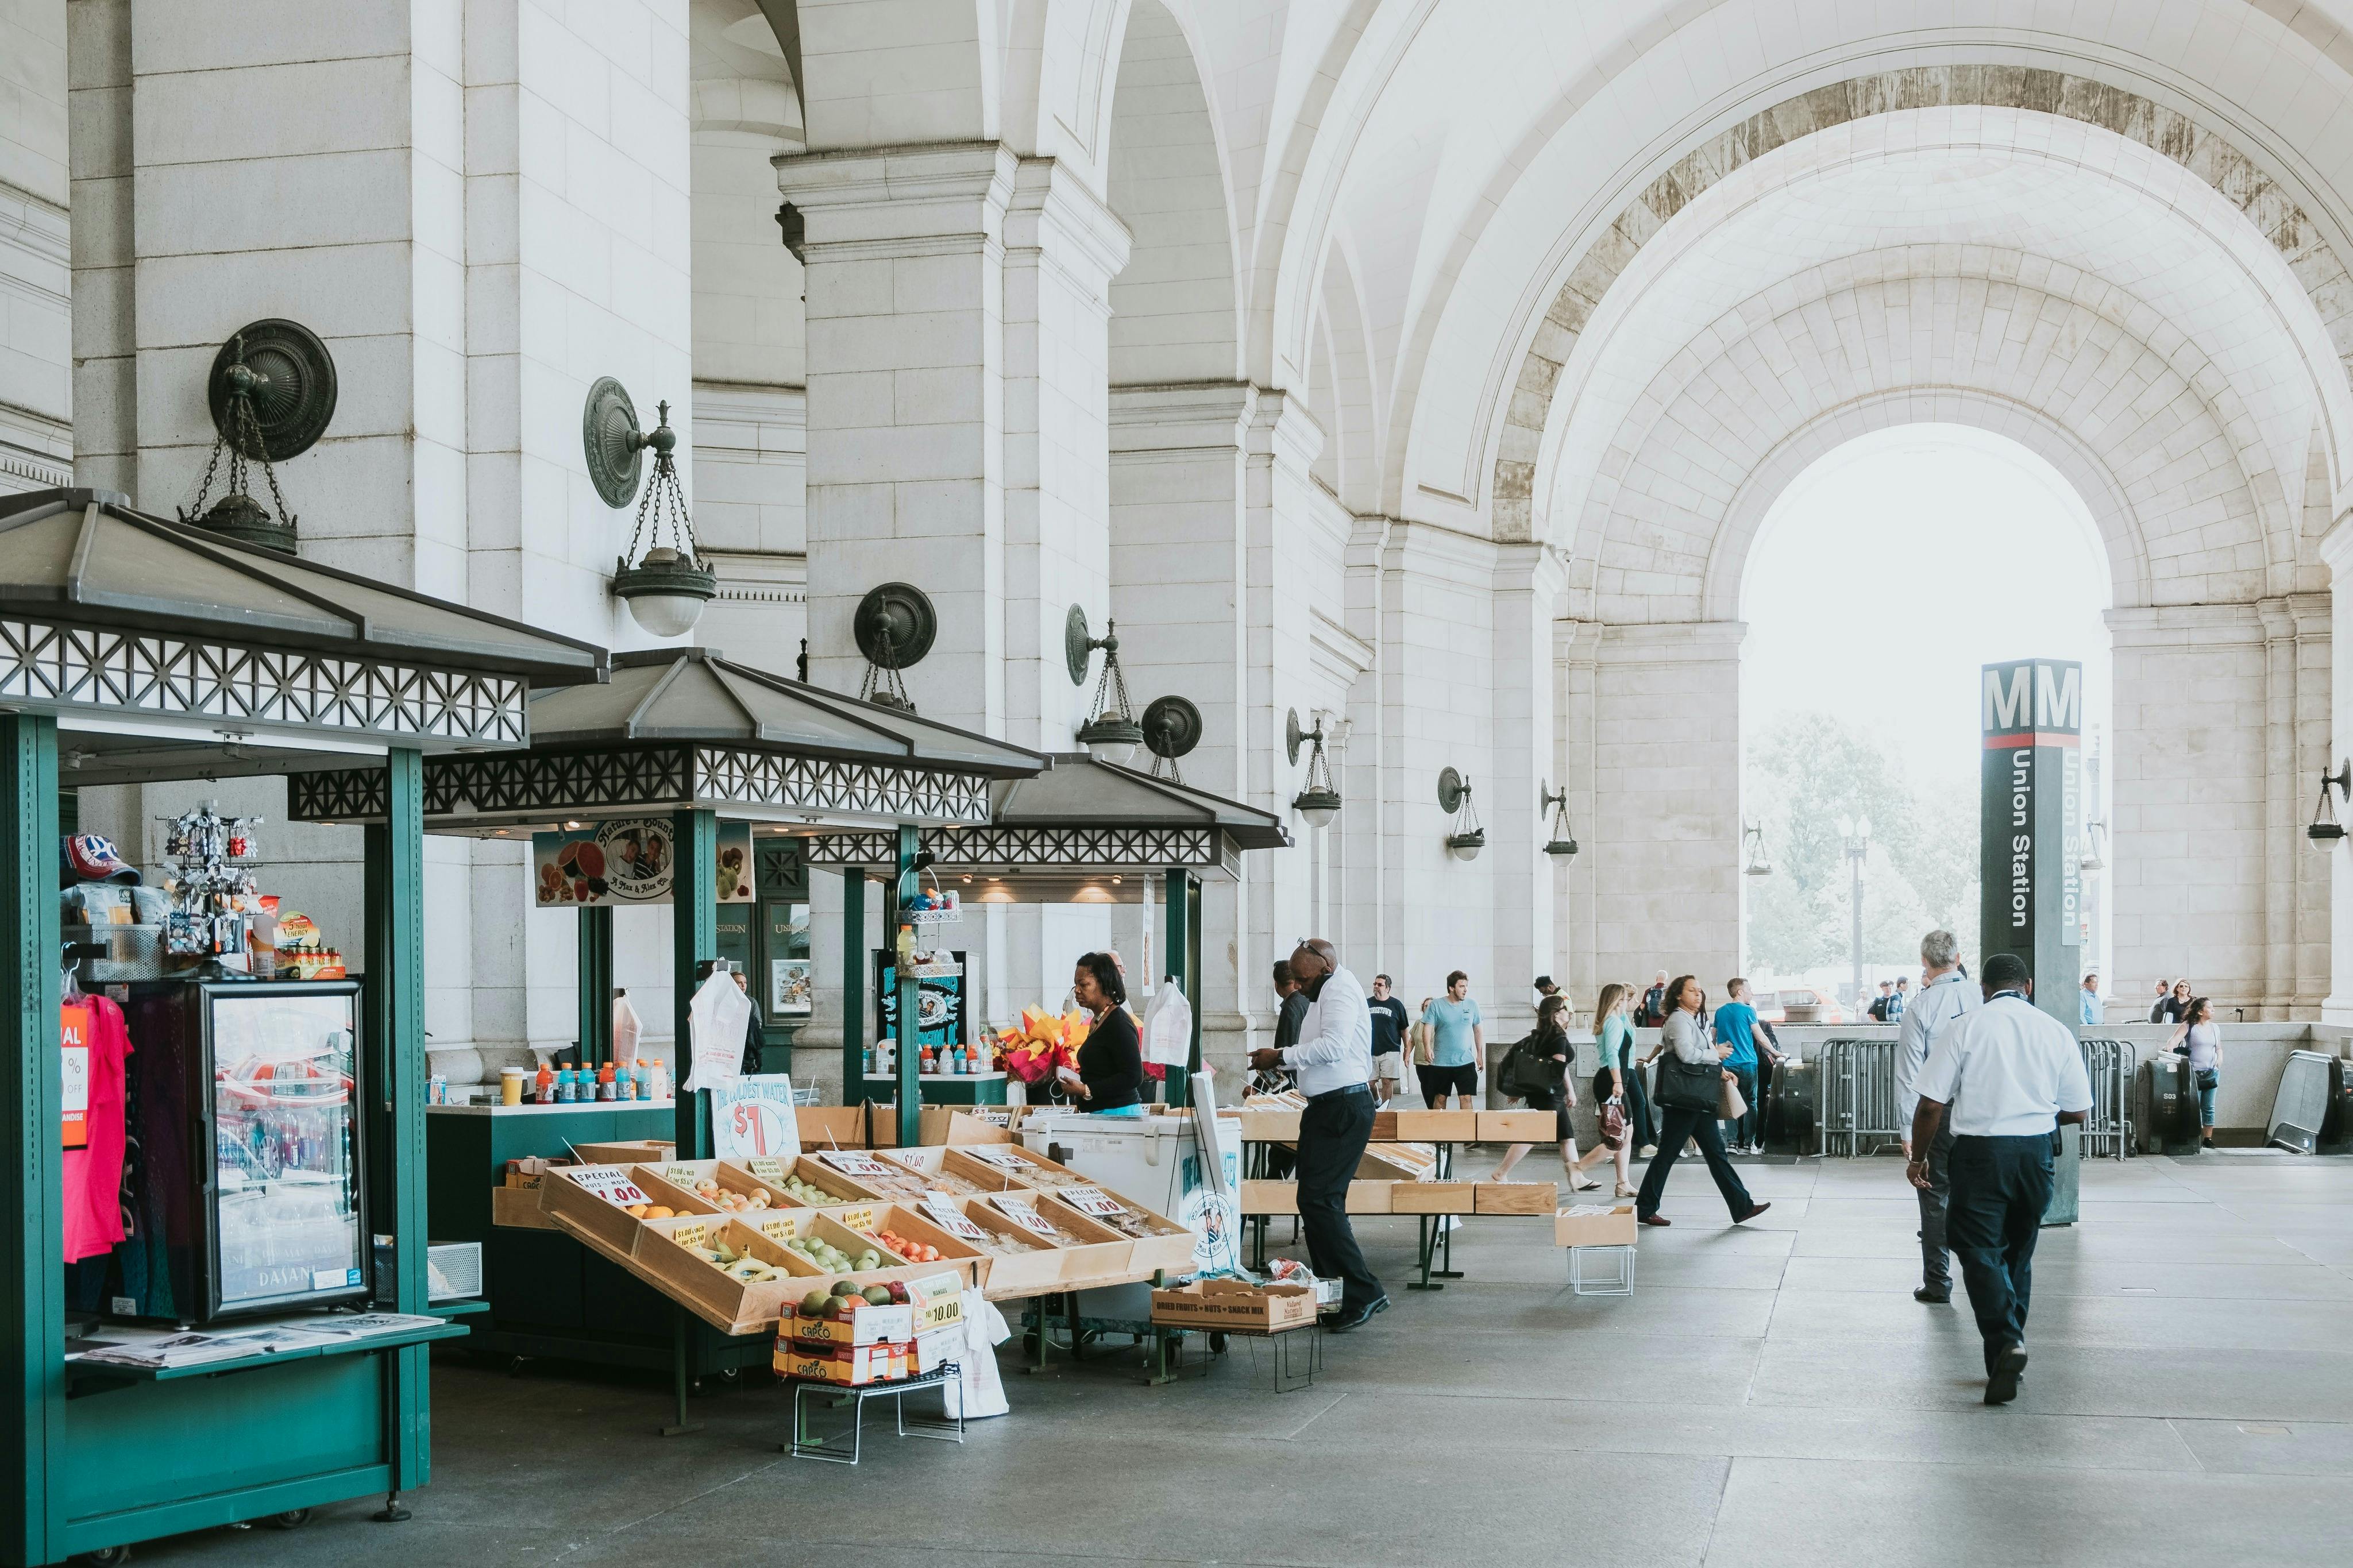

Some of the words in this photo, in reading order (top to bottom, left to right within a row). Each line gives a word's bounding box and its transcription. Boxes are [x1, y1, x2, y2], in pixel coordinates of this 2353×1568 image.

[1984, 666, 2031, 731] M
[2038, 665, 2080, 728] M
[2012, 750, 2031, 826] Union
[2063, 750, 2078, 827] Union
[598, 818, 638, 848] Natures
[2012, 835, 2030, 927] Station
[2063, 835, 2079, 926] Station
[618, 882, 634, 891] Max
[641, 883, 657, 893] Alex
[289, 921, 307, 930] 5-hour
[716, 925, 746, 933] STATION
[287, 929, 308, 937] ENERGY
[1369, 1006, 1392, 1017] ORGETOWN
[61, 1026, 82, 1044] AL
[67, 1084, 82, 1094] OFF
[717, 1089, 728, 1111] THE
[761, 1082, 790, 1107] WATER
[62, 1113, 83, 1122] ANDISE
[577, 1171, 623, 1181] SPECIAL
[847, 1212, 859, 1221] $1.00
[766, 1222, 780, 1230] $1.00
[859, 1219, 872, 1227] $500
[678, 1228, 691, 1238] $1.00
[690, 1234, 704, 1243] $500
[260, 1265, 315, 1287] DASANI
[1156, 1301, 1175, 1311] DRIED
[1175, 1303, 1198, 1312] FRUITS
[1228, 1306, 1250, 1314] SNACK
[1251, 1307, 1264, 1315] MIX
[801, 1326, 831, 1339] CAPCO
[797, 1364, 827, 1378] CAPCO
